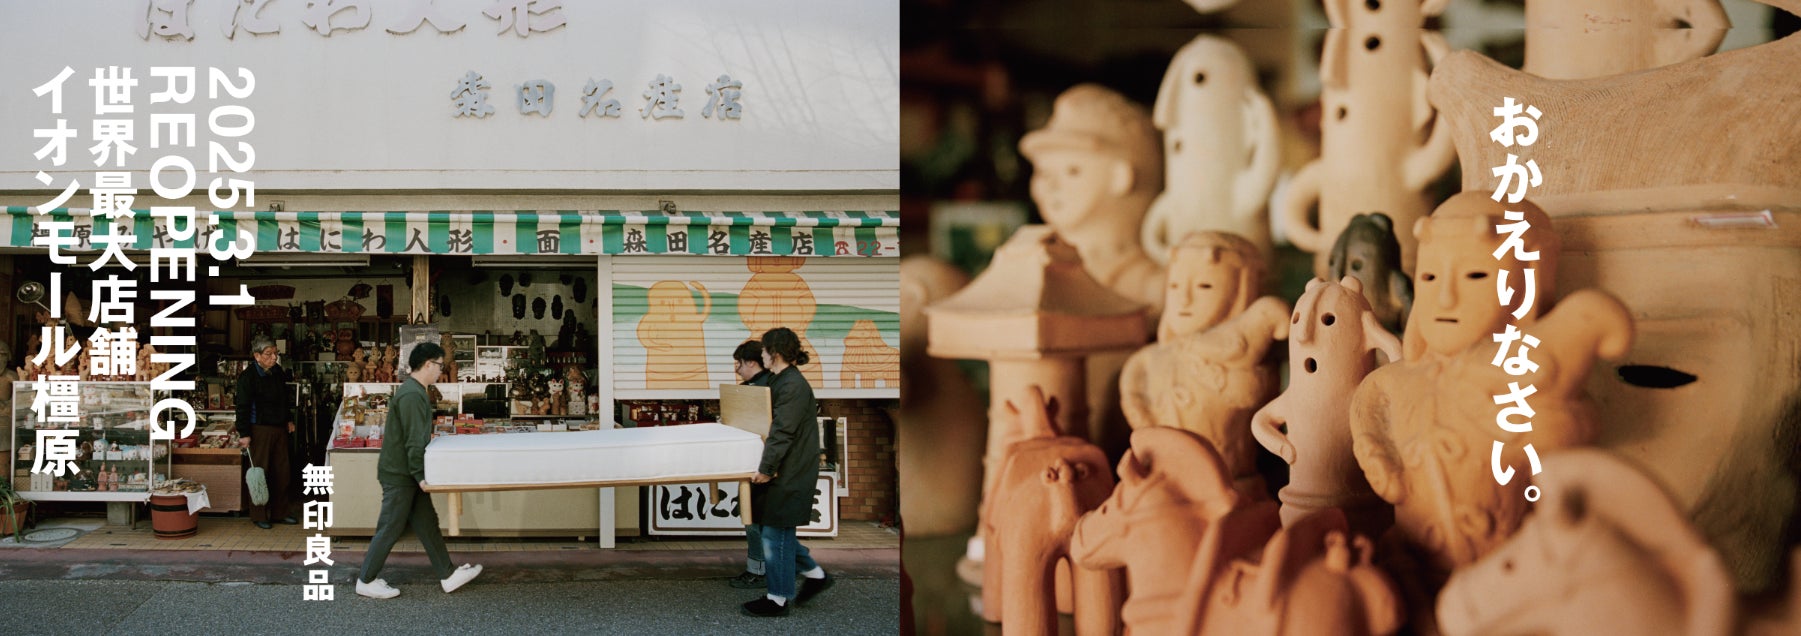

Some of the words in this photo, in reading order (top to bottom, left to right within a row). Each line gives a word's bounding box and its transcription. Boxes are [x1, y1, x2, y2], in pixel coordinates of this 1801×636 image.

[451, 70, 744, 120] 森田名産店
[856, 239, 900, 257] 22-
